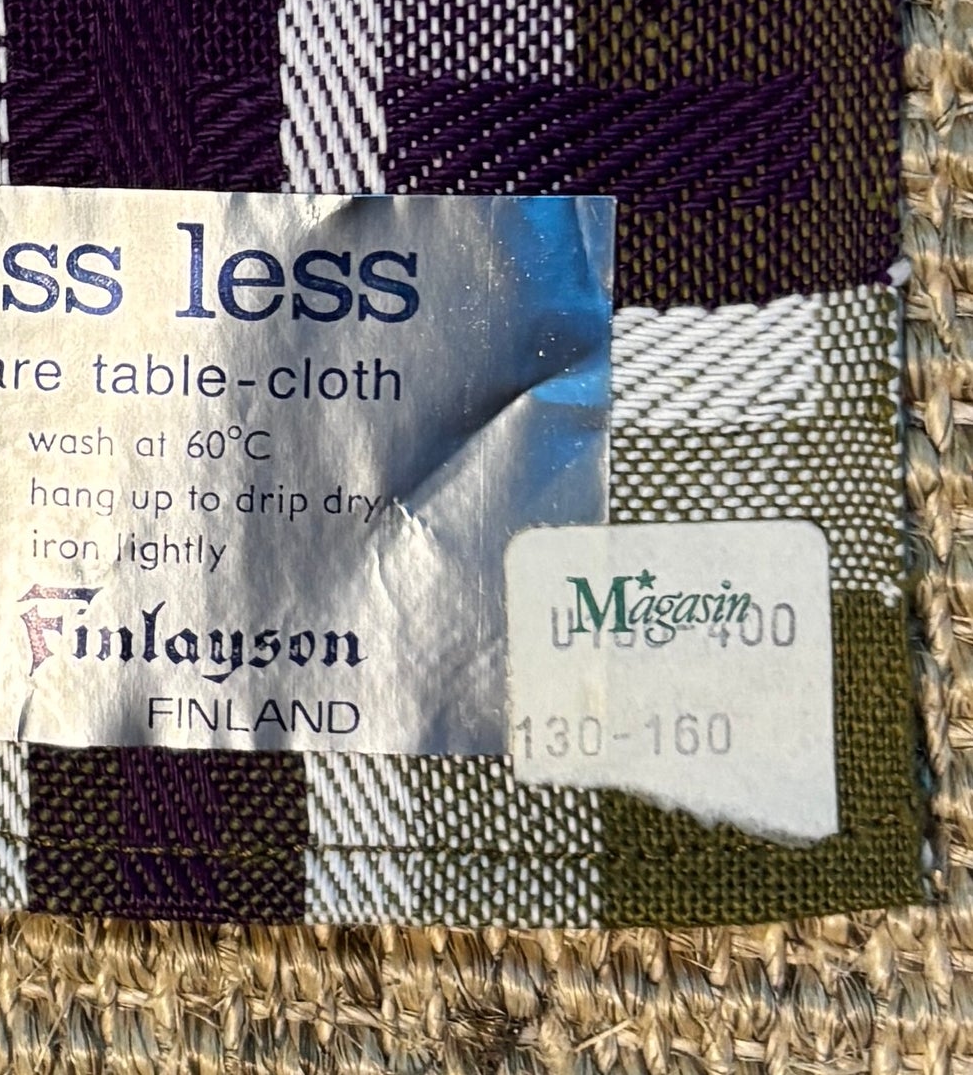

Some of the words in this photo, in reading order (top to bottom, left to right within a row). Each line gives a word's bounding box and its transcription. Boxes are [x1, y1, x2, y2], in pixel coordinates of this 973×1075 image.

[175, 222, 421, 323] less
[28, 428, 115, 457] wash
[135, 433, 167, 459] at
[186, 425, 272, 461] 60°C
[29, 478, 115, 517] hang
[131, 487, 174, 519] up
[188, 485, 221, 512] to
[235, 485, 309, 519] drip
[323, 485, 384, 524] dry
[30, 529, 99, 561] iron
[116, 530, 227, 572] lightly
[17, 582, 368, 685] Finlayson
[565, 576, 752, 645] Magasin
[147, 696, 361, 735] FINLAND
[514, 711, 733, 760] 130-160
